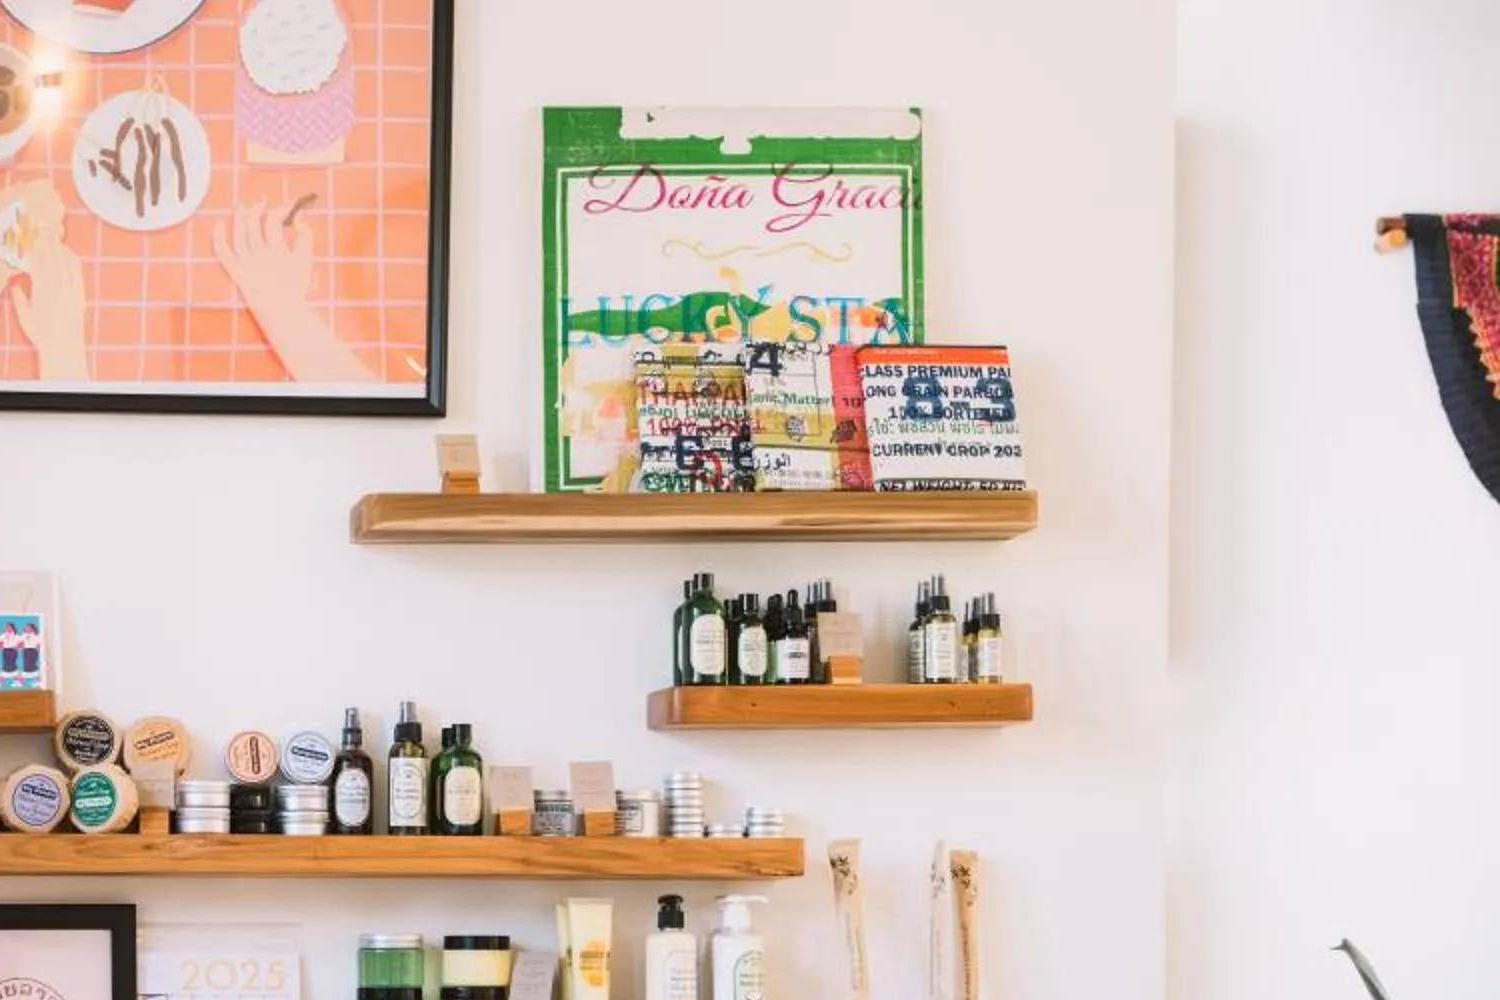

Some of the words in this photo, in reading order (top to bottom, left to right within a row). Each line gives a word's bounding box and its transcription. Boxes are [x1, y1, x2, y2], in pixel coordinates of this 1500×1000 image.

[583, 163, 752, 214] Doña
[907, 365, 983, 379] PREMIUM
[873, 443, 943, 457] CURRENT
[946, 445, 991, 457] CROP
[180, 957, 287, 992] 2025
